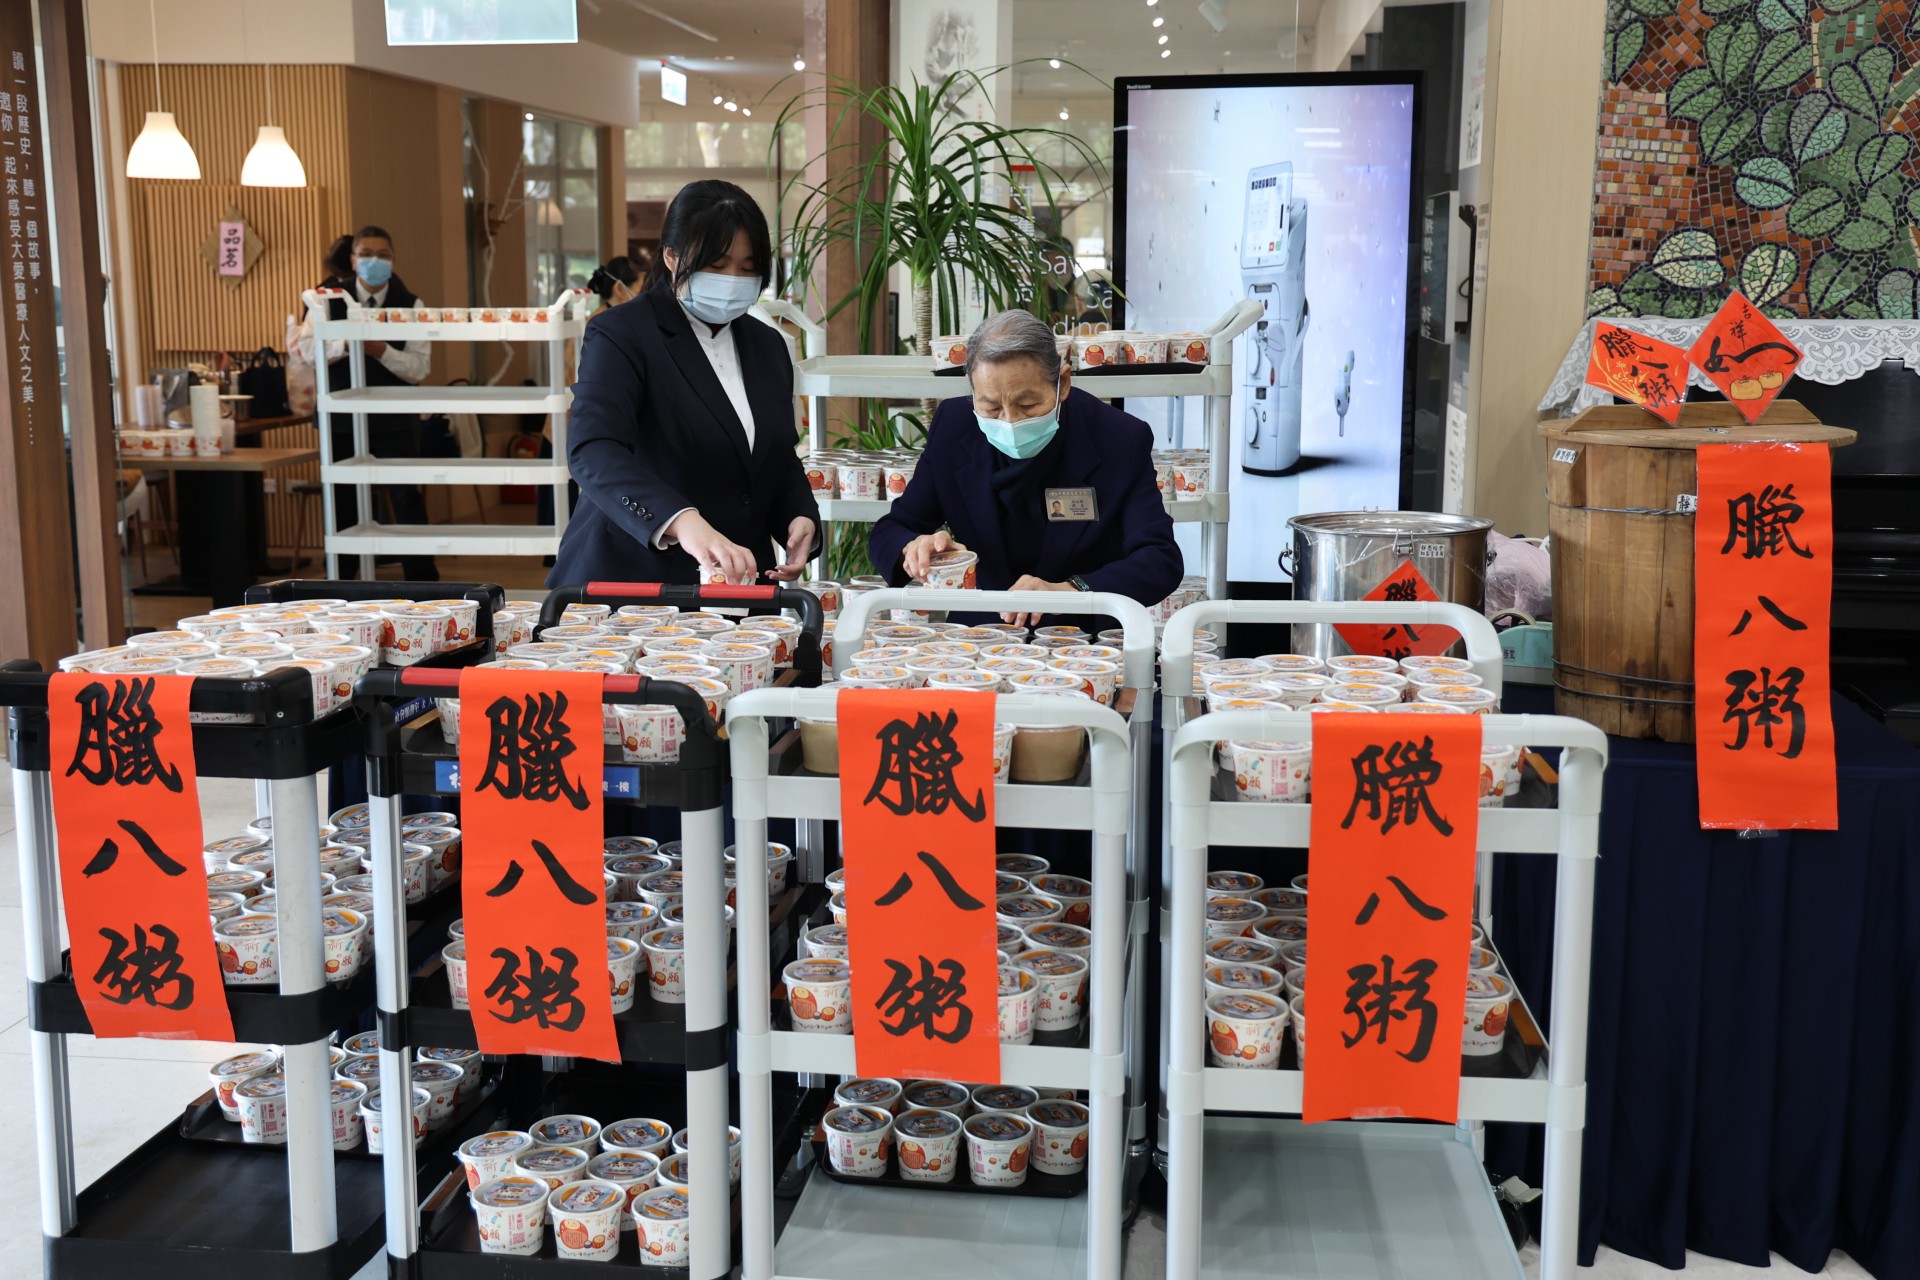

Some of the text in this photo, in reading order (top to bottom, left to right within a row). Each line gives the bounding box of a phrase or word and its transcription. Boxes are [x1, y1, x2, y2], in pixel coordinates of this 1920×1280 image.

[1597, 328, 1681, 409] 臘八粥
[1729, 302, 1753, 350] 吉祥
[1721, 484, 1814, 759] 臘八粥
[65, 677, 196, 1011] 臘八粥
[475, 690, 599, 1032] 臘八粥
[863, 708, 987, 1044] 臘八粥
[1341, 735, 1454, 1063] 臘八粥
